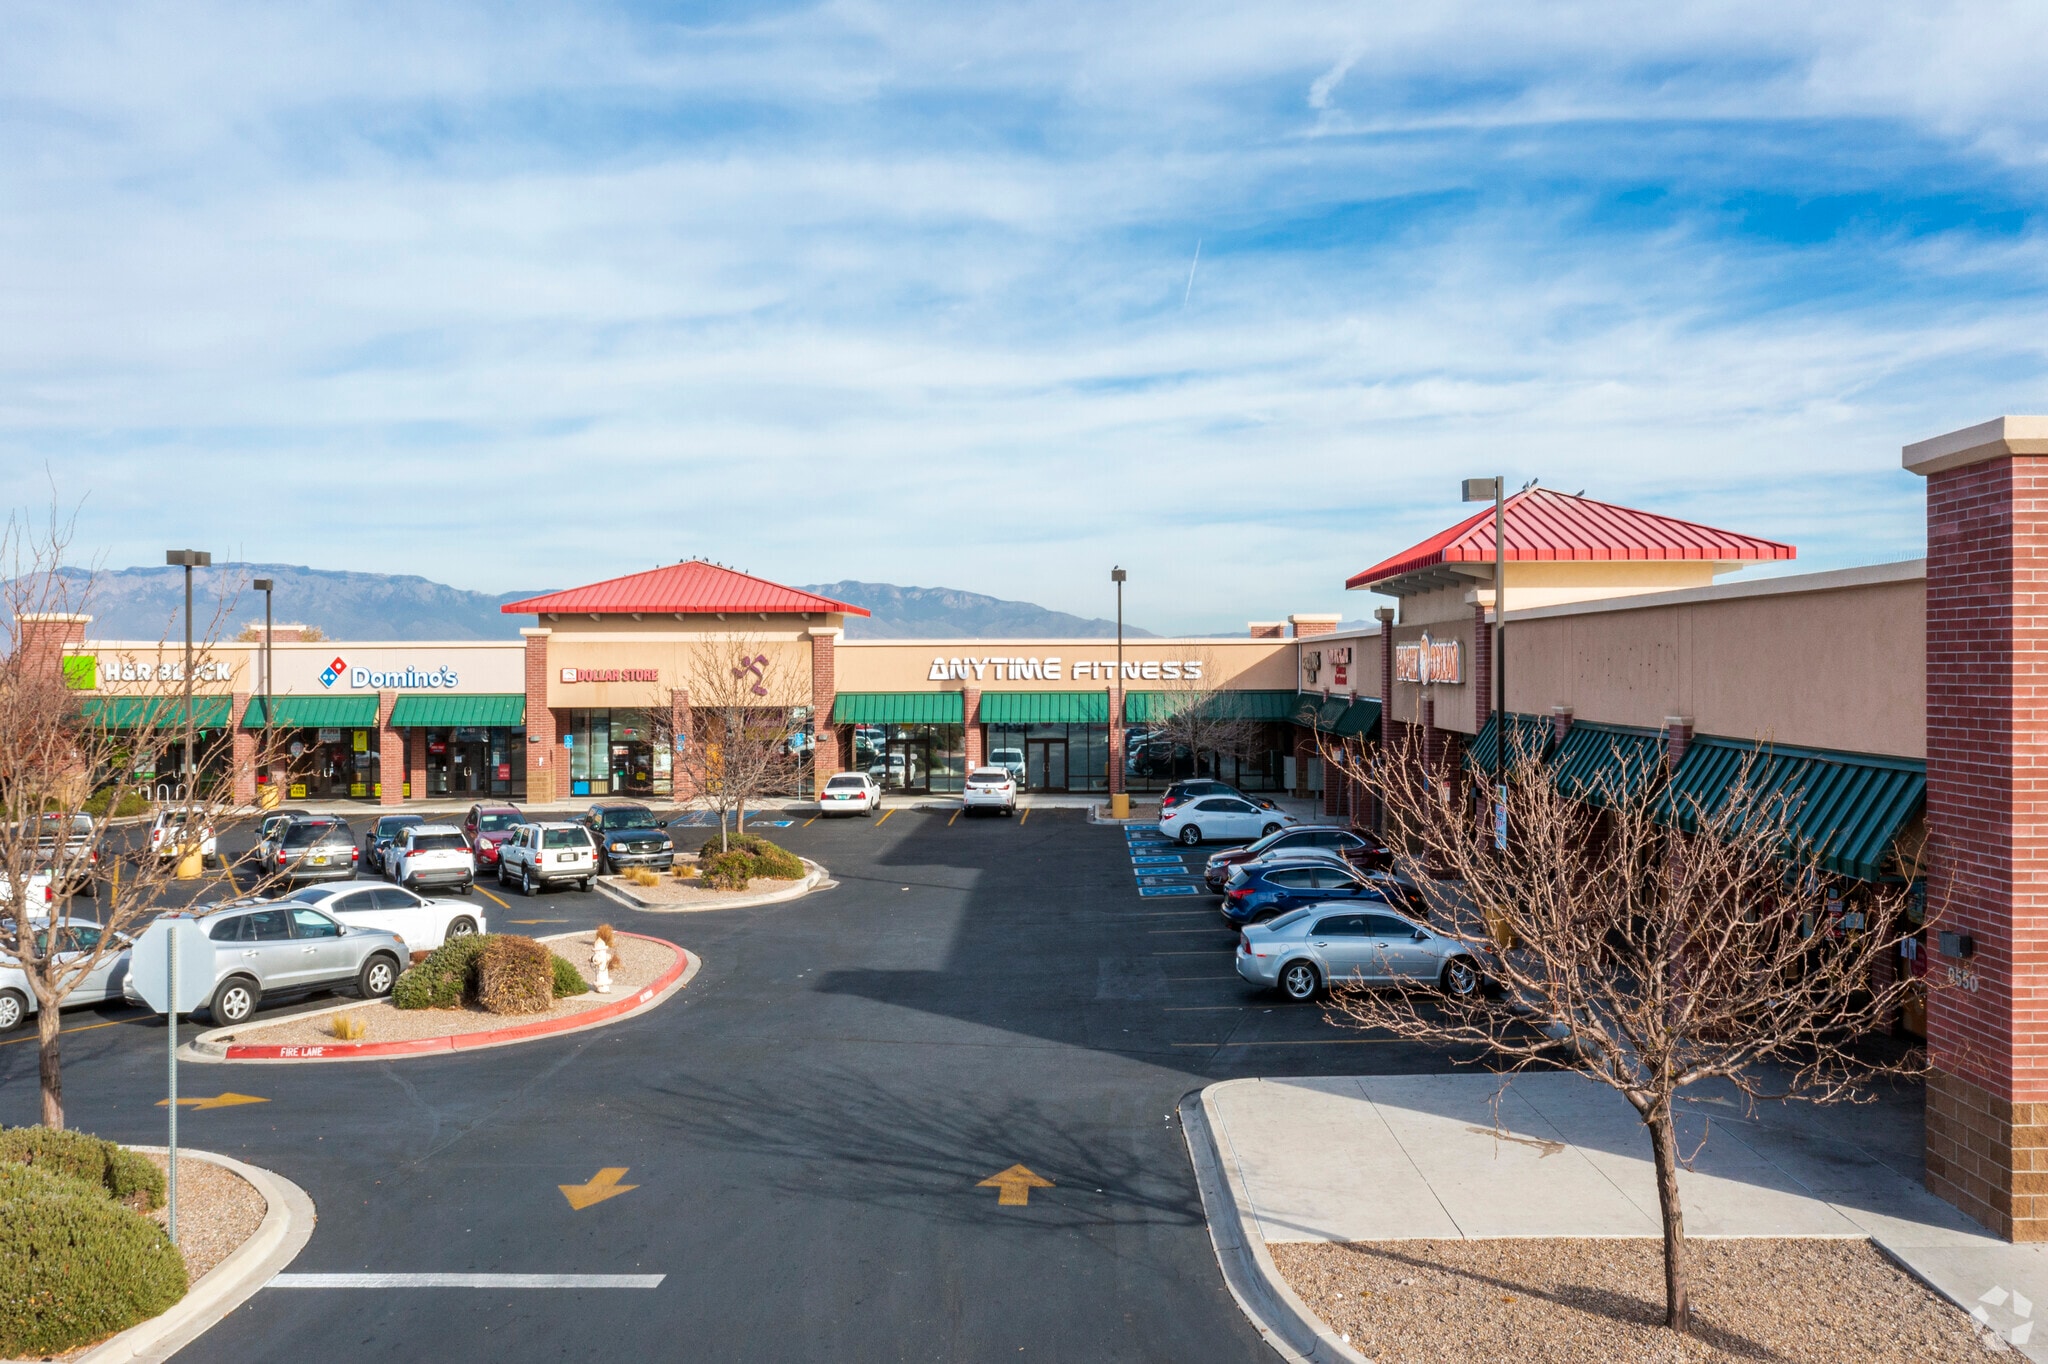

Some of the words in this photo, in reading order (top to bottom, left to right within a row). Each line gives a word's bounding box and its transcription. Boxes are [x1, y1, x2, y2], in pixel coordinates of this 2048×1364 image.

[104, 662, 152, 681] H&R
[350, 664, 459, 689] Domino's
[577, 668, 621, 683] DOLLAR
[621, 668, 659, 683] STORE
[928, 657, 1062, 681] ANYTIME
[1071, 661, 1204, 681] FITNESS
[280, 1047, 299, 1057] FIRE
[301, 1047, 323, 1057] LANE
